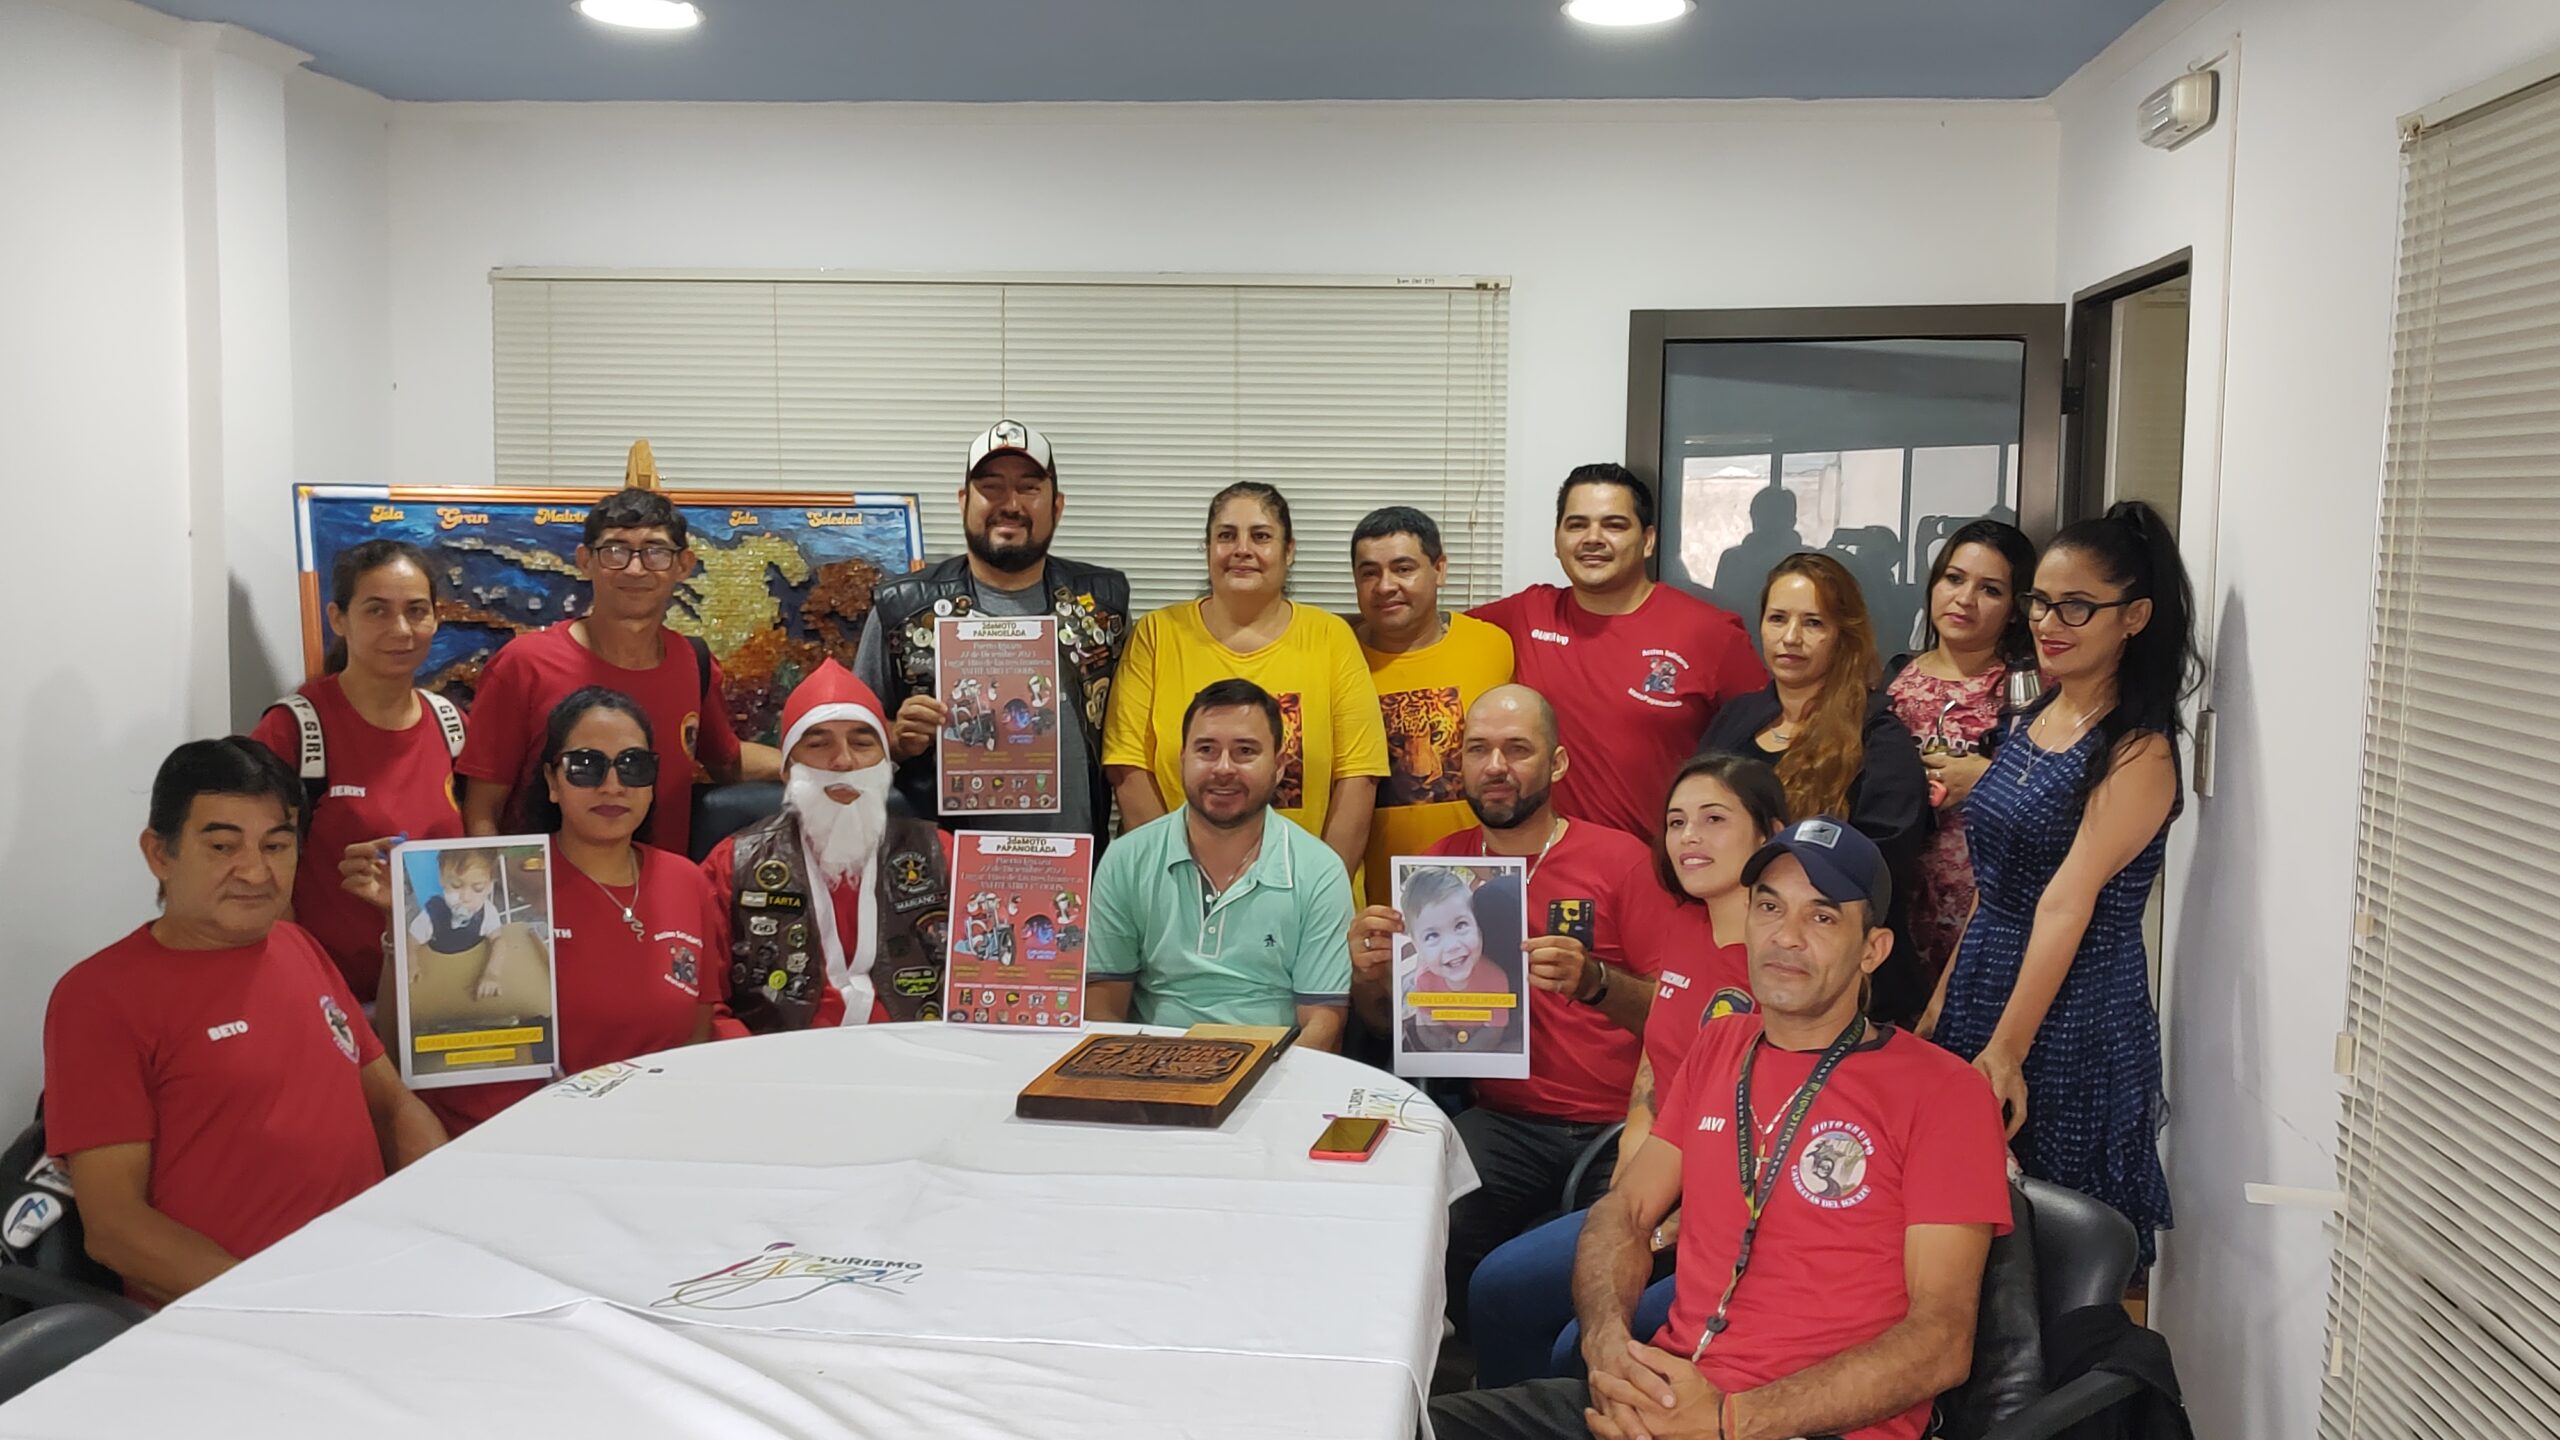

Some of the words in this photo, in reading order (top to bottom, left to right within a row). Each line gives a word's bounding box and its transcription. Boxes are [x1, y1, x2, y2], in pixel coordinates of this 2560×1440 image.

[370, 505, 404, 522] Isla
[436, 506, 489, 530] Gran
[534, 508, 588, 525] Malvin
[729, 510, 759, 527] Isla
[806, 511, 864, 528] Soledad
[304, 721, 321, 763] GIRL
[996, 844, 1057, 853] PAPANOELADA
[769, 896, 801, 907] TARTA
[1698, 1116, 1726, 1132] JAVI
[818, 1255, 923, 1270] TURISMO
